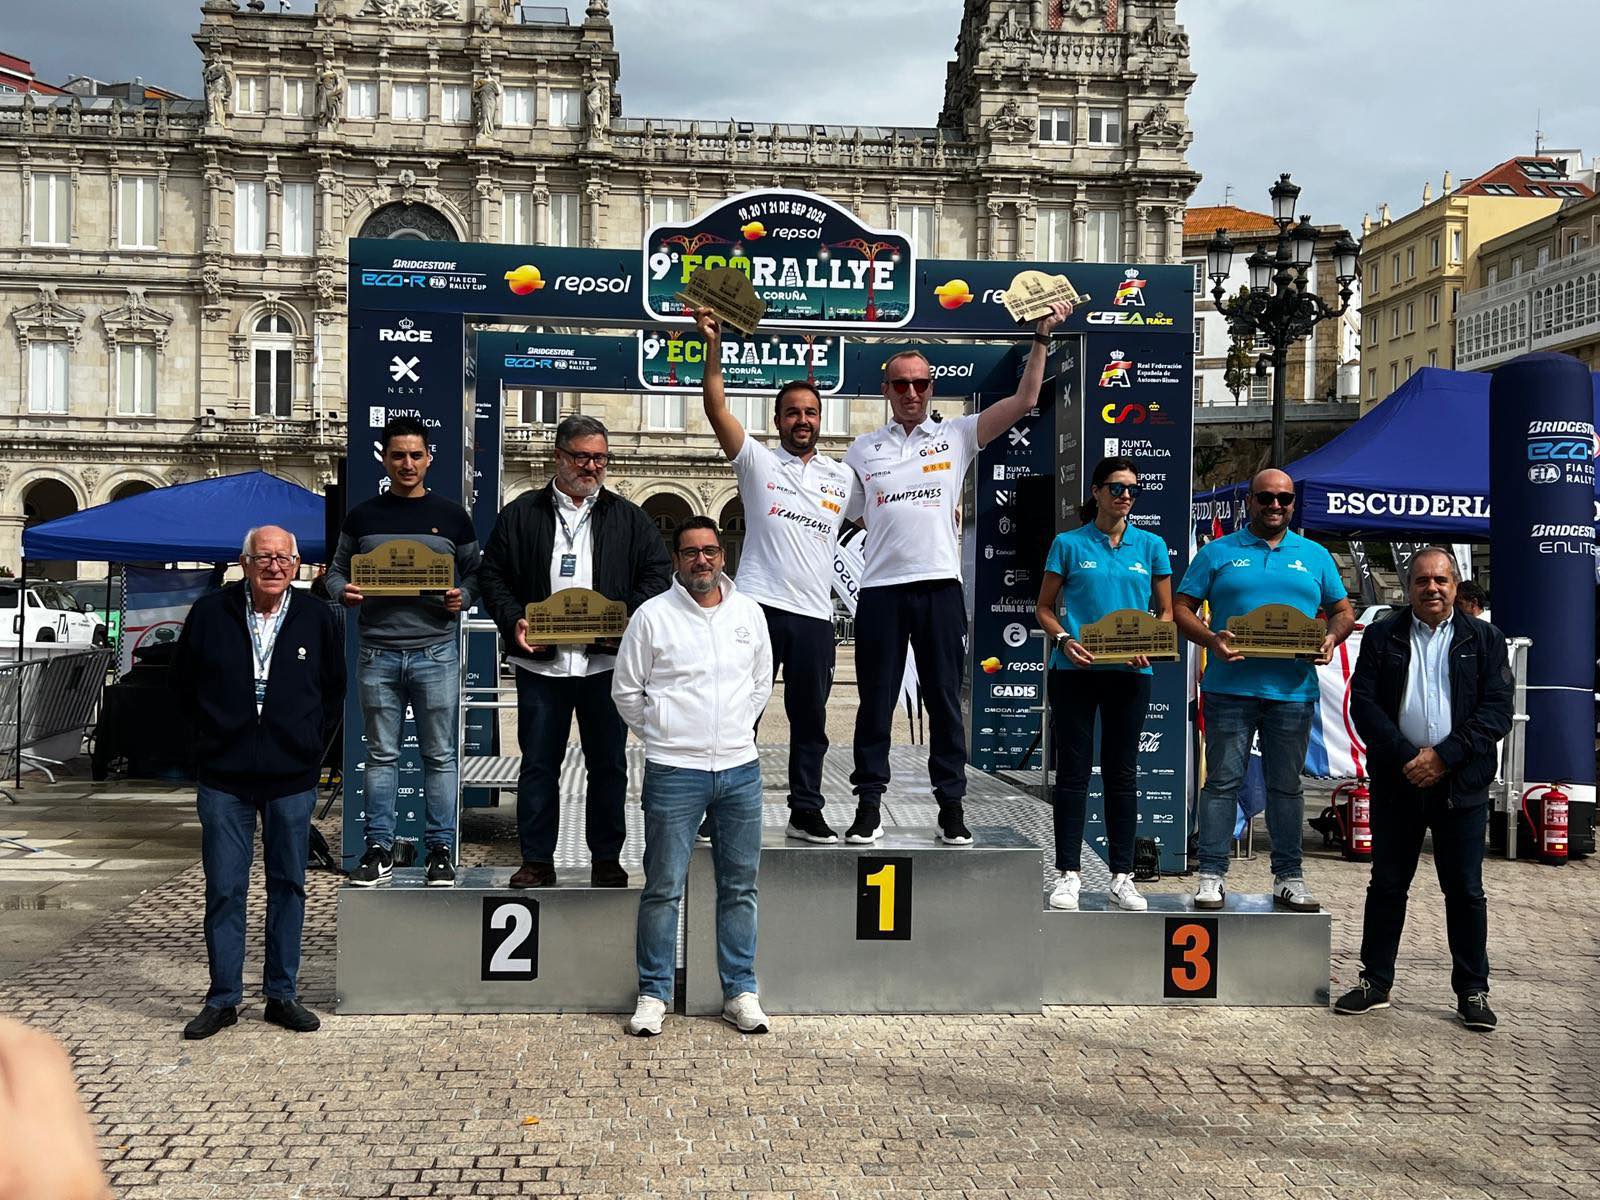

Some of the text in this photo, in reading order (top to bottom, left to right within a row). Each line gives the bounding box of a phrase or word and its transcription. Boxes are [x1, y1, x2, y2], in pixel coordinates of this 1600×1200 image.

[738, 200, 827, 224] 19, 20 Y 21 DE SEP 2025
[772, 226, 822, 241] repsol
[392, 258, 457, 271] BRIDGESTONE
[462, 276, 477, 284] ECO
[554, 274, 632, 295] repsol
[763, 290, 807, 301] CORUÑA
[1146, 317, 1174, 325] RACE
[379, 329, 433, 342] RACE
[527, 346, 575, 356] BRIDGESTONE
[728, 366, 763, 375] CORUÑA
[929, 362, 974, 379] epsol
[388, 408, 421, 418] XUNTA
[1121, 440, 1152, 448] XUNTA
[1121, 449, 1171, 457] DE GALICIA
[1529, 465, 1559, 482] FIA
[1565, 463, 1582, 473] FIA
[1566, 474, 1592, 485] RALLY
[1326, 492, 1491, 518] ESCUDERI
[1539, 541, 1596, 556] ENLITE
[990, 604, 1016, 613] CULTURA
[1016, 605, 1025, 613] DE
[1007, 661, 1045, 673] repso
[993, 685, 1036, 697] GADIS
[1148, 703, 1170, 711] TION
[866, 864, 896, 932] 1
[489, 902, 533, 972] 2
[1171, 923, 1211, 991] 3
